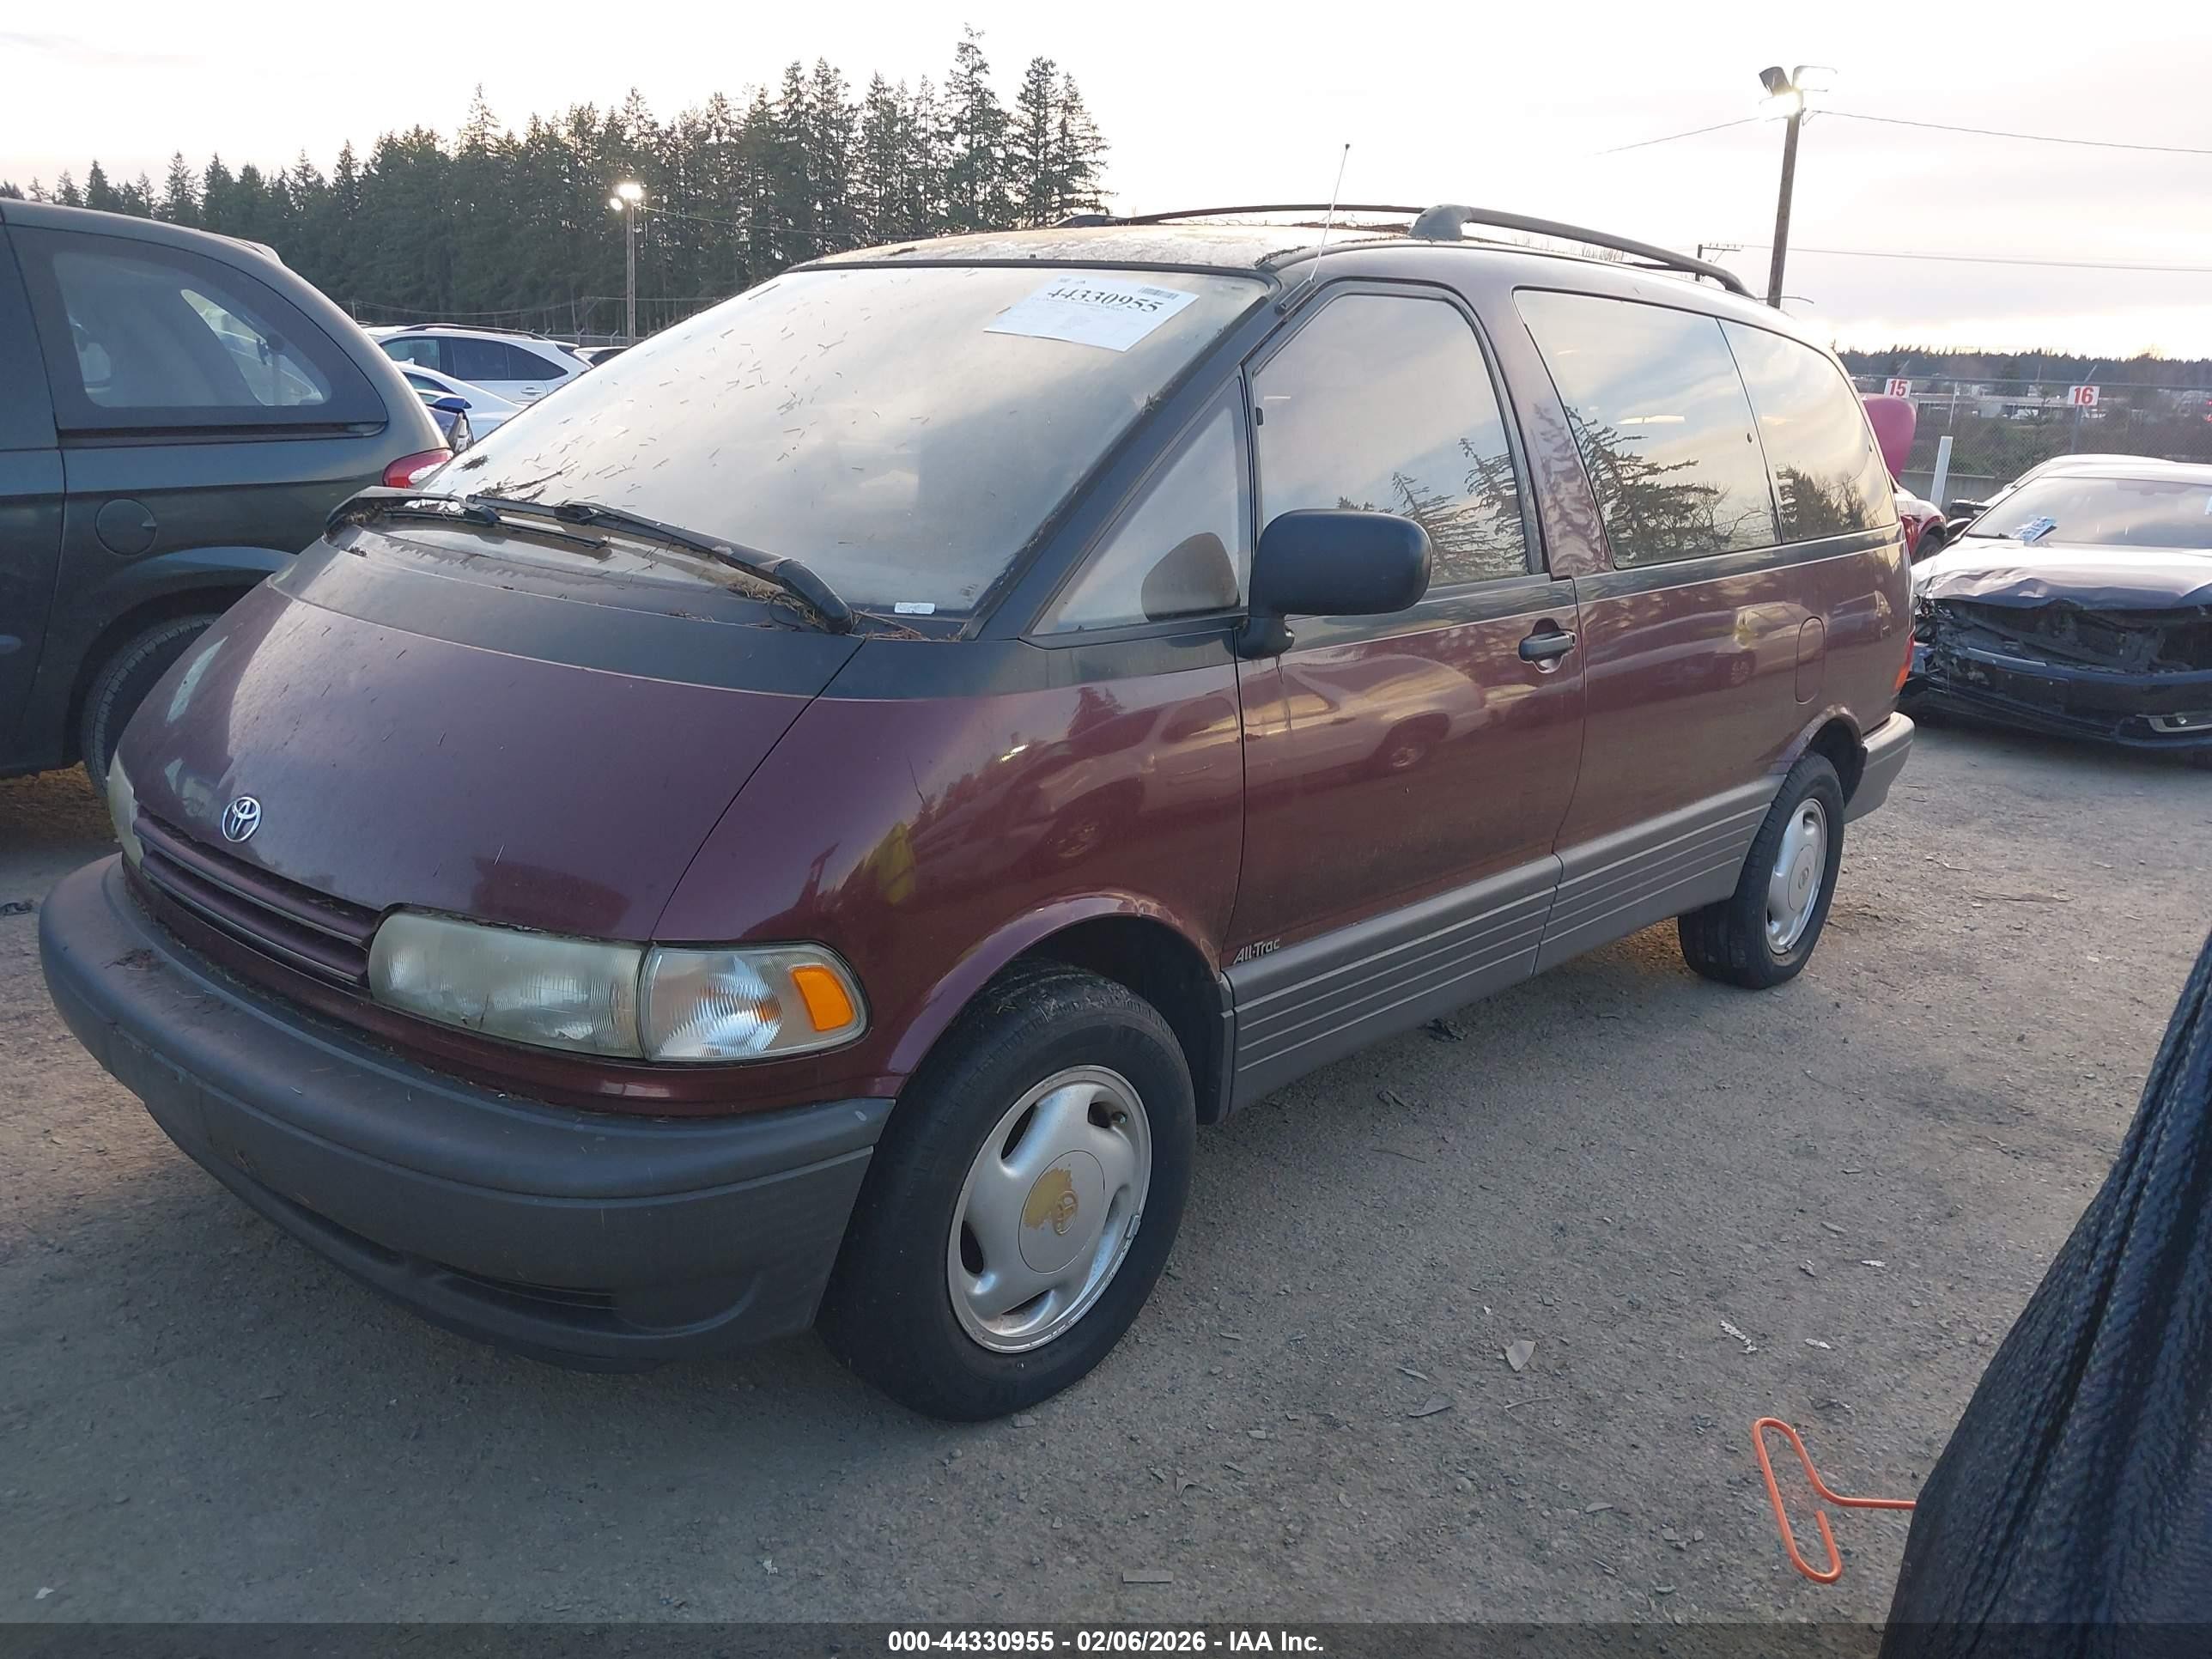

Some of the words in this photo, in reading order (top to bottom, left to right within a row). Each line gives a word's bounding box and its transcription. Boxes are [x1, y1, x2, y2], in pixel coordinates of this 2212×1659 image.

[1048, 288, 1164, 313] 44330955
[1889, 380, 1908, 397] 15
[2075, 386, 2094, 404] 16
